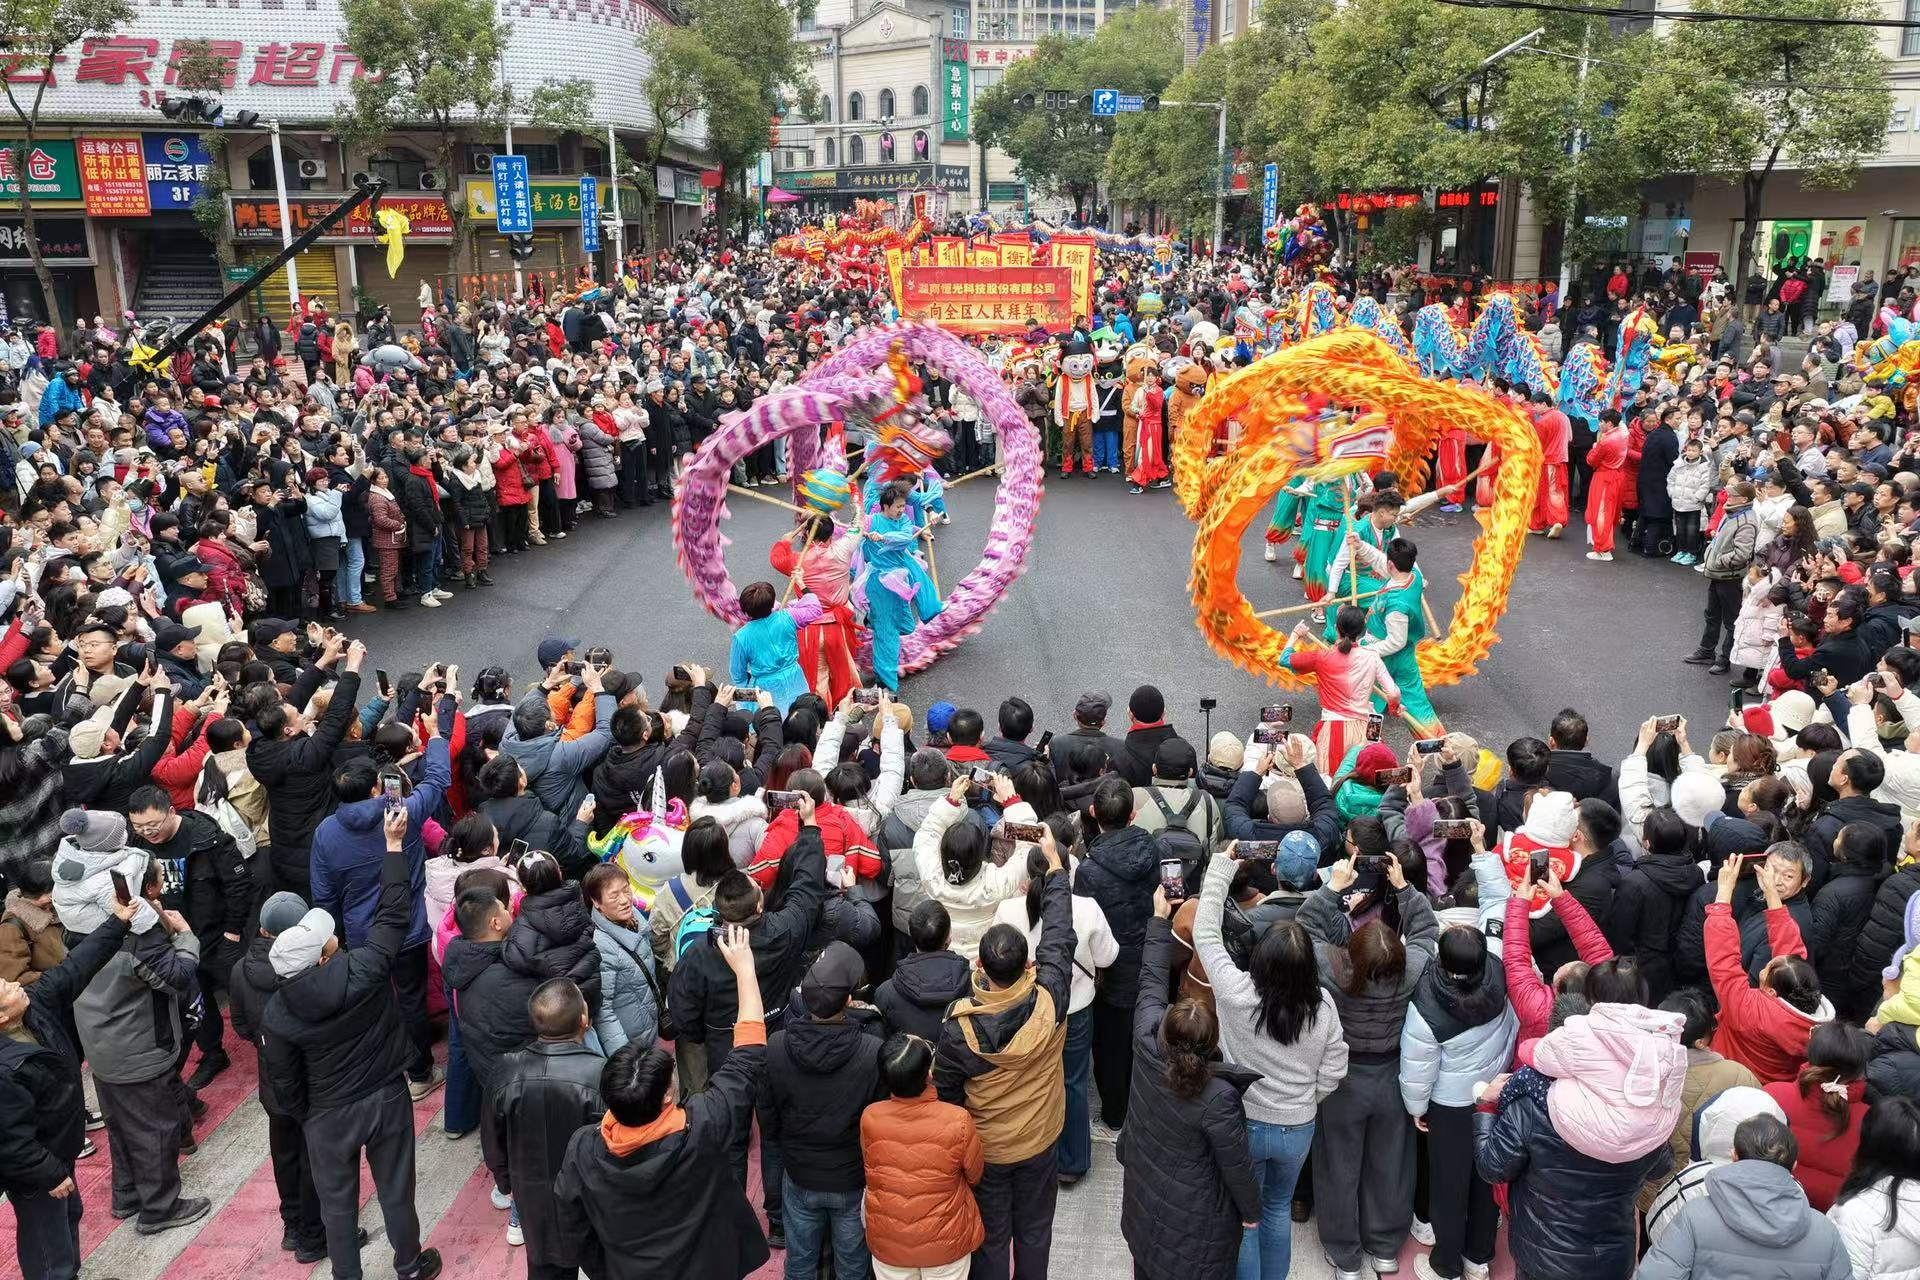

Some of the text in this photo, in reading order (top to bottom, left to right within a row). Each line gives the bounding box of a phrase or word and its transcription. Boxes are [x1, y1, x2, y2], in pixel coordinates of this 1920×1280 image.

[950, 66, 962, 132] 急救中心
[82, 141, 138, 154] 运输公司
[84, 155, 140, 167] 所有门面
[86, 168, 142, 180] 低价出售
[145, 164, 209, 181] 丽云家居
[172, 187, 190, 201] 3F
[511, 161, 528, 227] 行人请走斑马线
